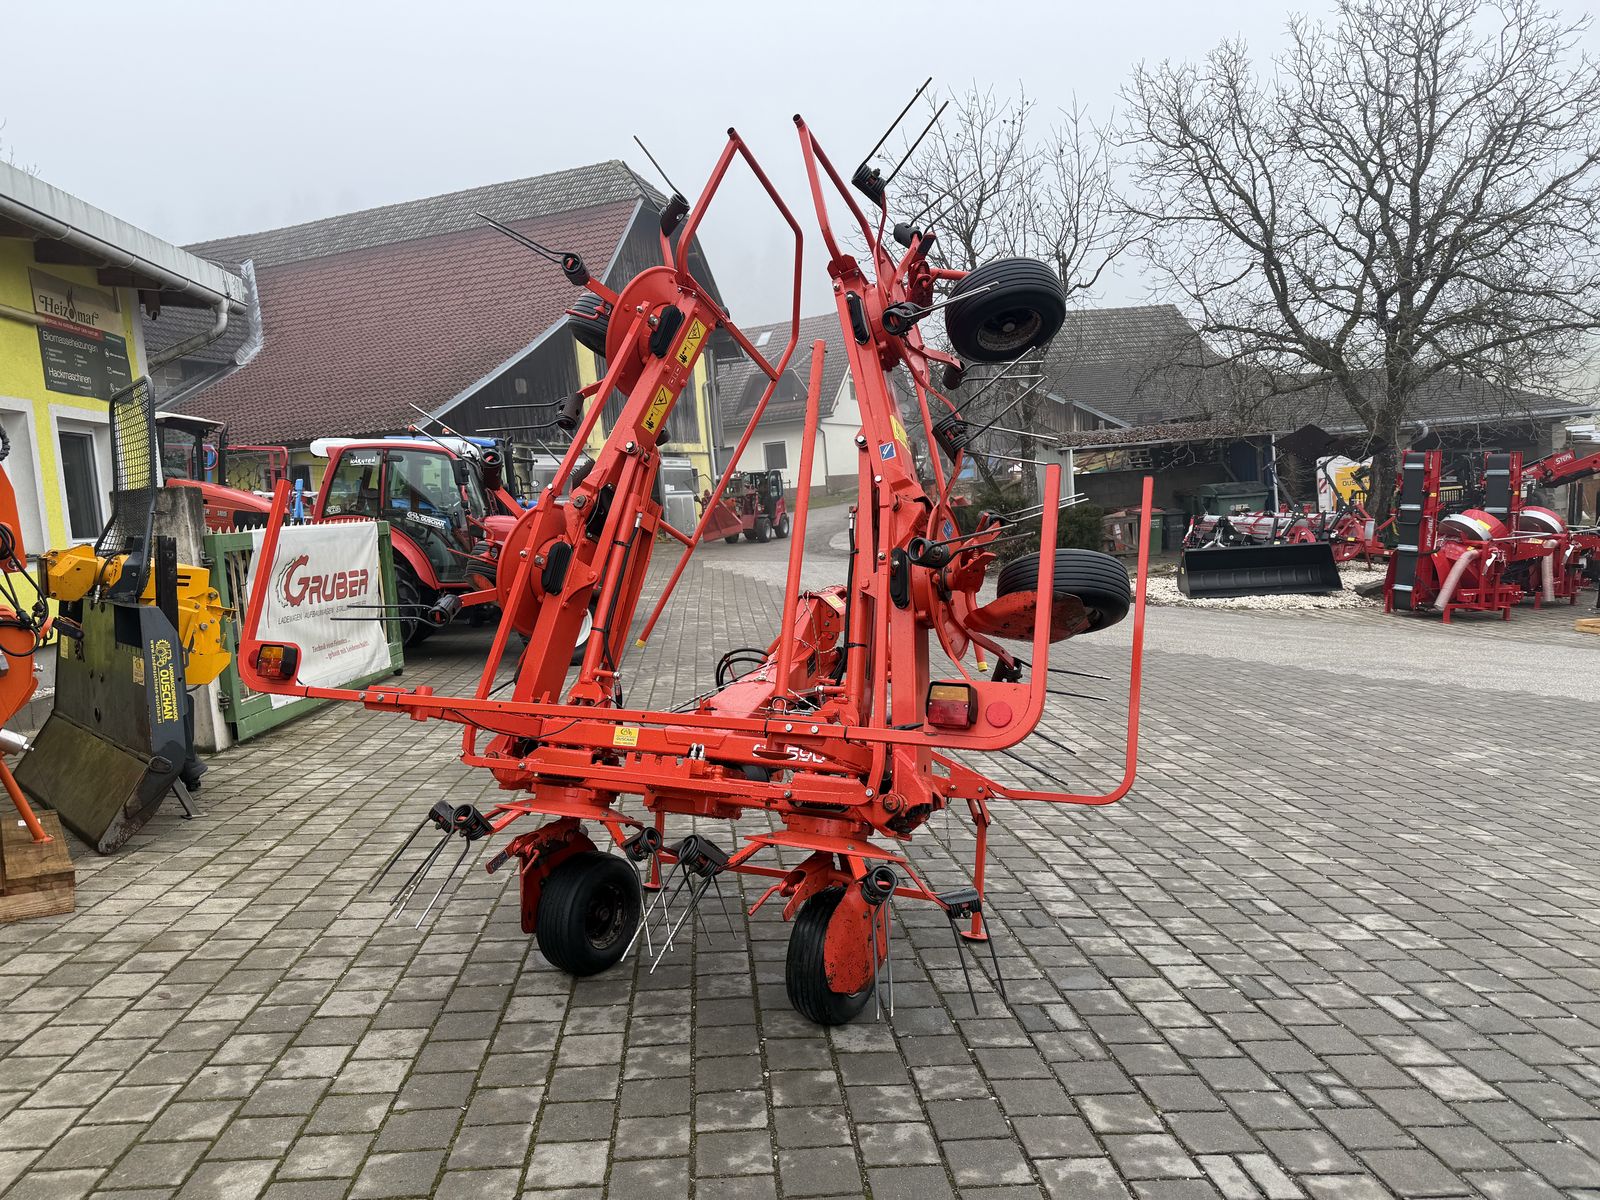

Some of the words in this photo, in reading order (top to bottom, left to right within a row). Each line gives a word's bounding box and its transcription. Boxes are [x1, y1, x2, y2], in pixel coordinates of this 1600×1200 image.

[42, 330, 98, 354] Biomasseheizungen
[48, 366, 92, 385] Hackmaschinen
[280, 554, 369, 608] GRUBER
[277, 612, 303, 625] LADEWAGEN
[149, 639, 162, 724] www.landmaschinen-ouschan.at
[159, 669, 174, 720] OUSCHAN
[168, 662, 179, 722] LANDMASCHINENHANDEL
